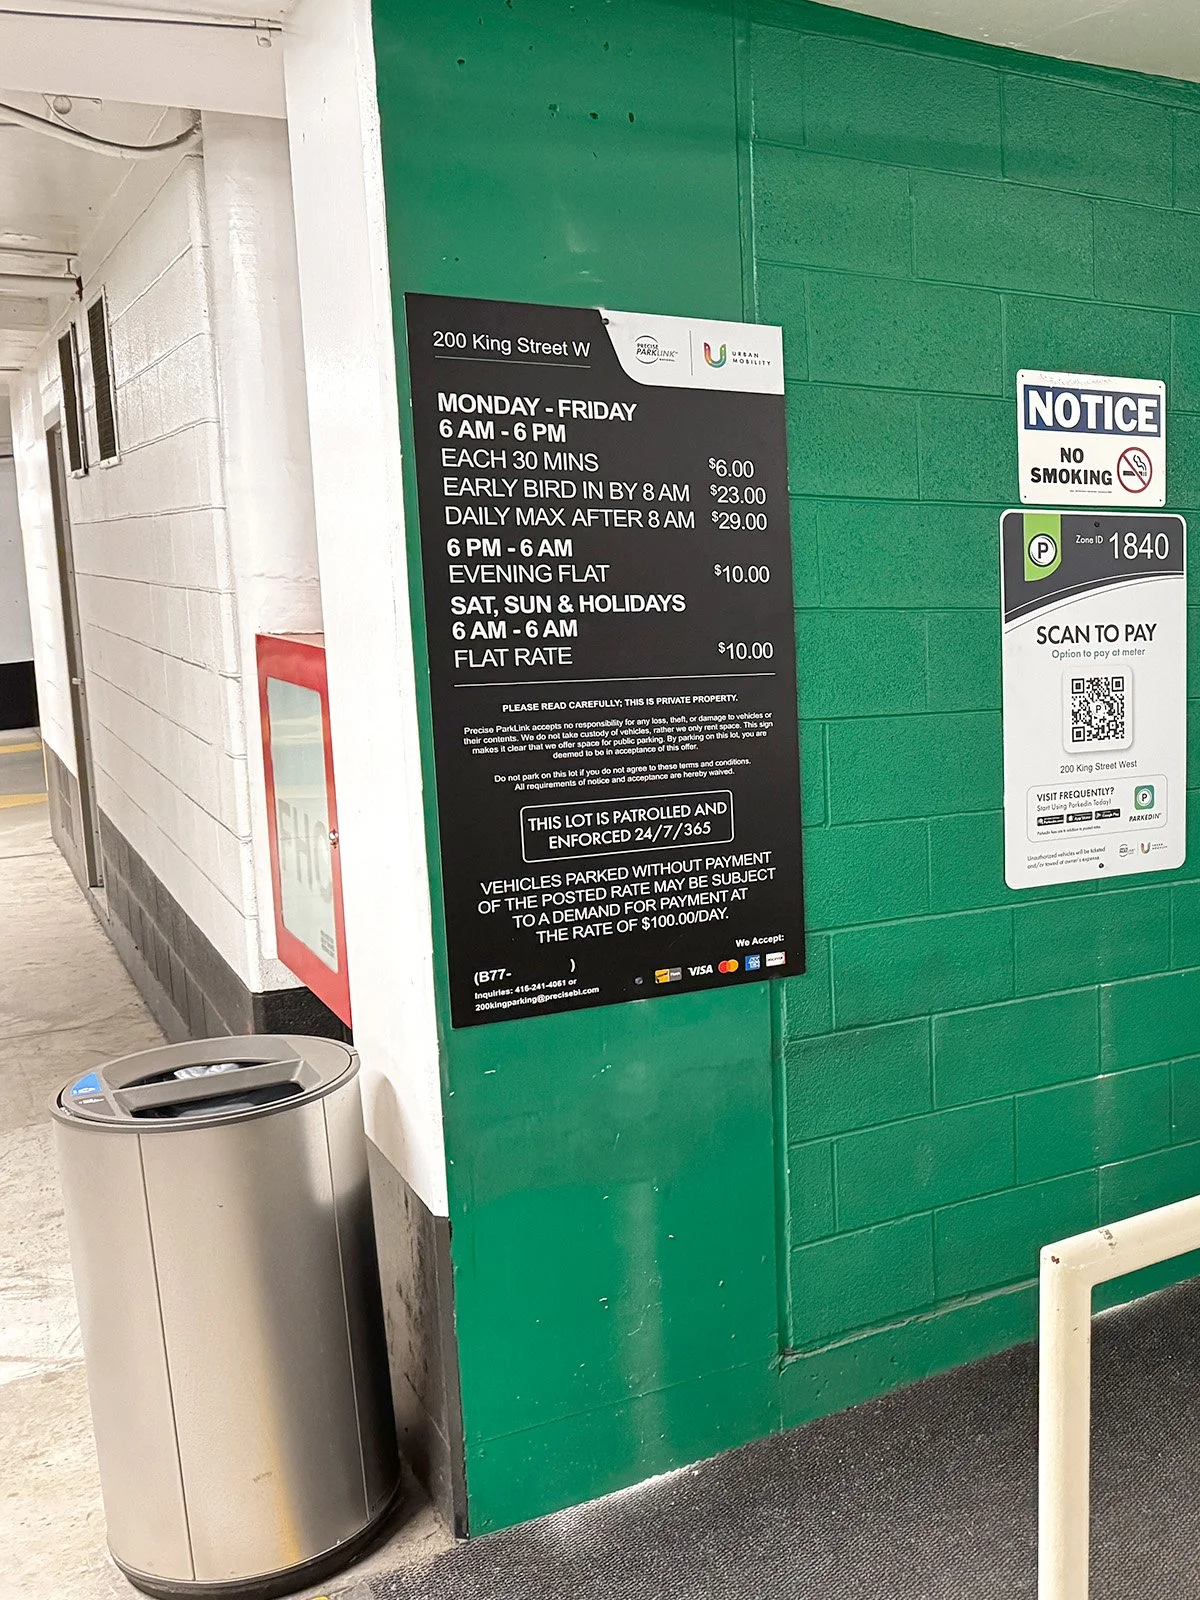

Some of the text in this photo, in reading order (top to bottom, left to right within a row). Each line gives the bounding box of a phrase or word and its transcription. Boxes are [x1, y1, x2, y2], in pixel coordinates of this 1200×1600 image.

[433, 331, 590, 357] 200 King Street W
[732, 358, 772, 366] MOBILITY
[438, 392, 540, 416] MONDAY
[558, 399, 637, 421] FRIDAY
[1028, 390, 1158, 432] NOTICE
[439, 419, 453, 438] 6
[457, 420, 494, 440] AM
[514, 422, 527, 441] 6
[532, 423, 566, 443] PM
[441, 448, 599, 472] EACH 30 MINS
[1060, 447, 1084, 464] NO
[709, 457, 754, 478] $6.00
[1030, 467, 1112, 486] SMOKING
[443, 477, 690, 502] EARLY BIRD IN BY 8 AM
[710, 484, 766, 504] $23.00
[445, 506, 695, 529] DAILY MAX AFTER 8 AM
[711, 510, 767, 530] $29.00
[447, 538, 461, 557] 6
[466, 538, 501, 557] PM
[520, 538, 533, 557] 6
[537, 538, 573, 557] AM
[1076, 532, 1170, 560] Zone ID 1840
[449, 564, 610, 583] EVENING FLAT
[714, 564, 770, 583] $10.00
[451, 594, 686, 618] SAT, SUN & HOLIDAYS
[452, 621, 466, 640] 6
[470, 621, 507, 640] AM
[525, 620, 538, 638] 6
[542, 619, 578, 638] AM
[1037, 623, 1157, 645] SCAN TO PAY
[454, 647, 573, 668] FLAT RATE
[718, 642, 773, 660] $10.00
[1051, 648, 1145, 661] Option to pay at meter
[503, 703, 539, 712] PLEASE
[541, 702, 567, 710] READ
[569, 699, 622, 709] CAREFULLY;
[624, 698, 644, 706] THIS
[656, 696, 691, 705] PRIVATE
[693, 694, 738, 703] PROPERTY.
[1060, 760, 1137, 774] 200 King Street West
[1037, 787, 1115, 802] VISIT FREQUENTLY?
[528, 802, 727, 831] THIS LOT IS PATROLLED AND
[549, 821, 711, 849] ENFORCED 24/7/365
[480, 851, 772, 895] VEHICLES PARKED WITHOUT PAYMENT
[478, 867, 776, 914] OF THE POSTED RATE MAY BE SUBJECT
[512, 887, 748, 928] TO A DEMAND FOR PAYMENT AT
[535, 907, 729, 943] THE RATE OF $100.00/DAY.
[736, 934, 785, 948] We Accept:
[473, 968, 512, 986] (B77-
[688, 964, 714, 976] VISA
[474, 988, 514, 1000] Inquiries:
